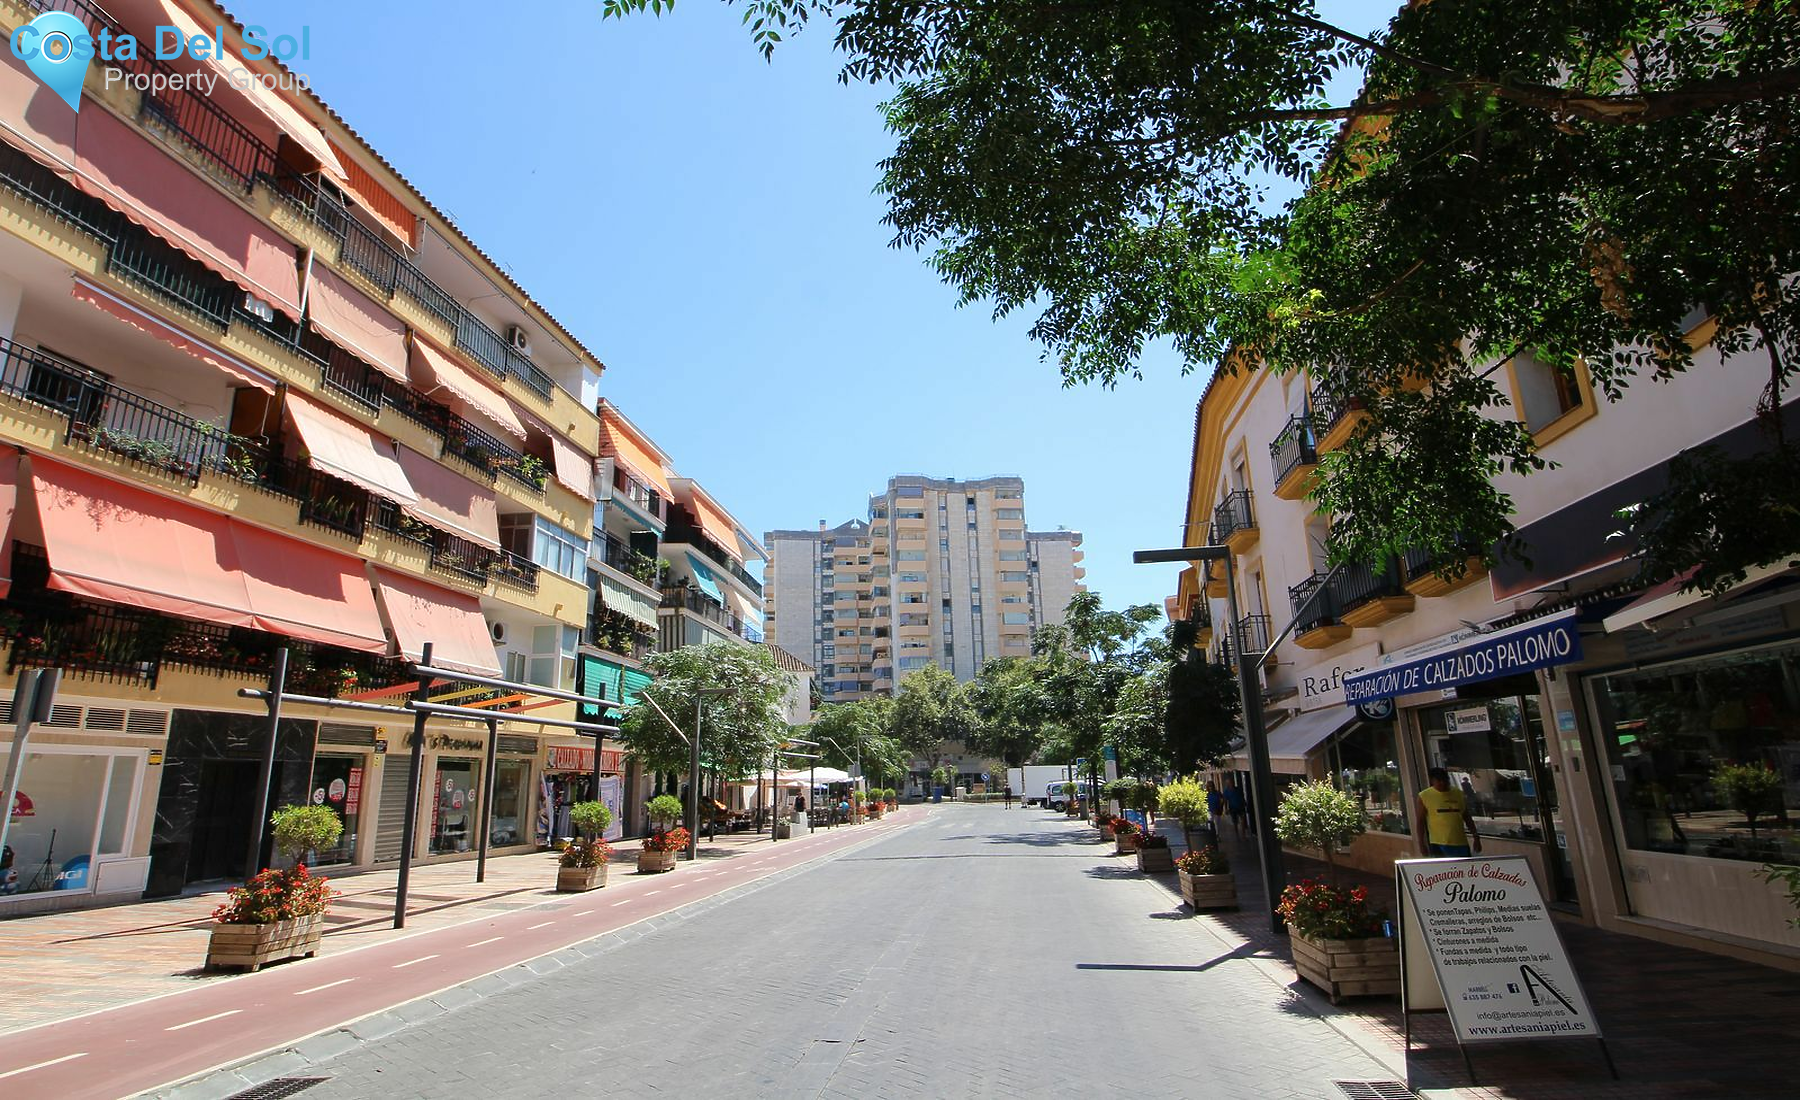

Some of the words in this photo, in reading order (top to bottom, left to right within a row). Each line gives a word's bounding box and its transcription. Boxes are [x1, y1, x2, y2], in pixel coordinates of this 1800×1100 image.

[1345, 670, 1401, 701] REPARACIÓN
[1404, 669, 1419, 688] DE
[1424, 648, 1495, 685] CALZADOS
[1498, 627, 1571, 669] PALOMO
[1303, 666, 1365, 698] Raf
[1414, 867, 1464, 891] Reparación
[1467, 865, 1479, 878] de
[1481, 863, 1527, 887] Calzados
[1443, 881, 1506, 904] Palomo
[1462, 927, 1487, 936] Zapatos
[1492, 925, 1514, 933] Bolsos
[1476, 1008, 1566, 1022] info@artesaniapiel.es
[1468, 1020, 1586, 1035] www.artesaniapiel.es
